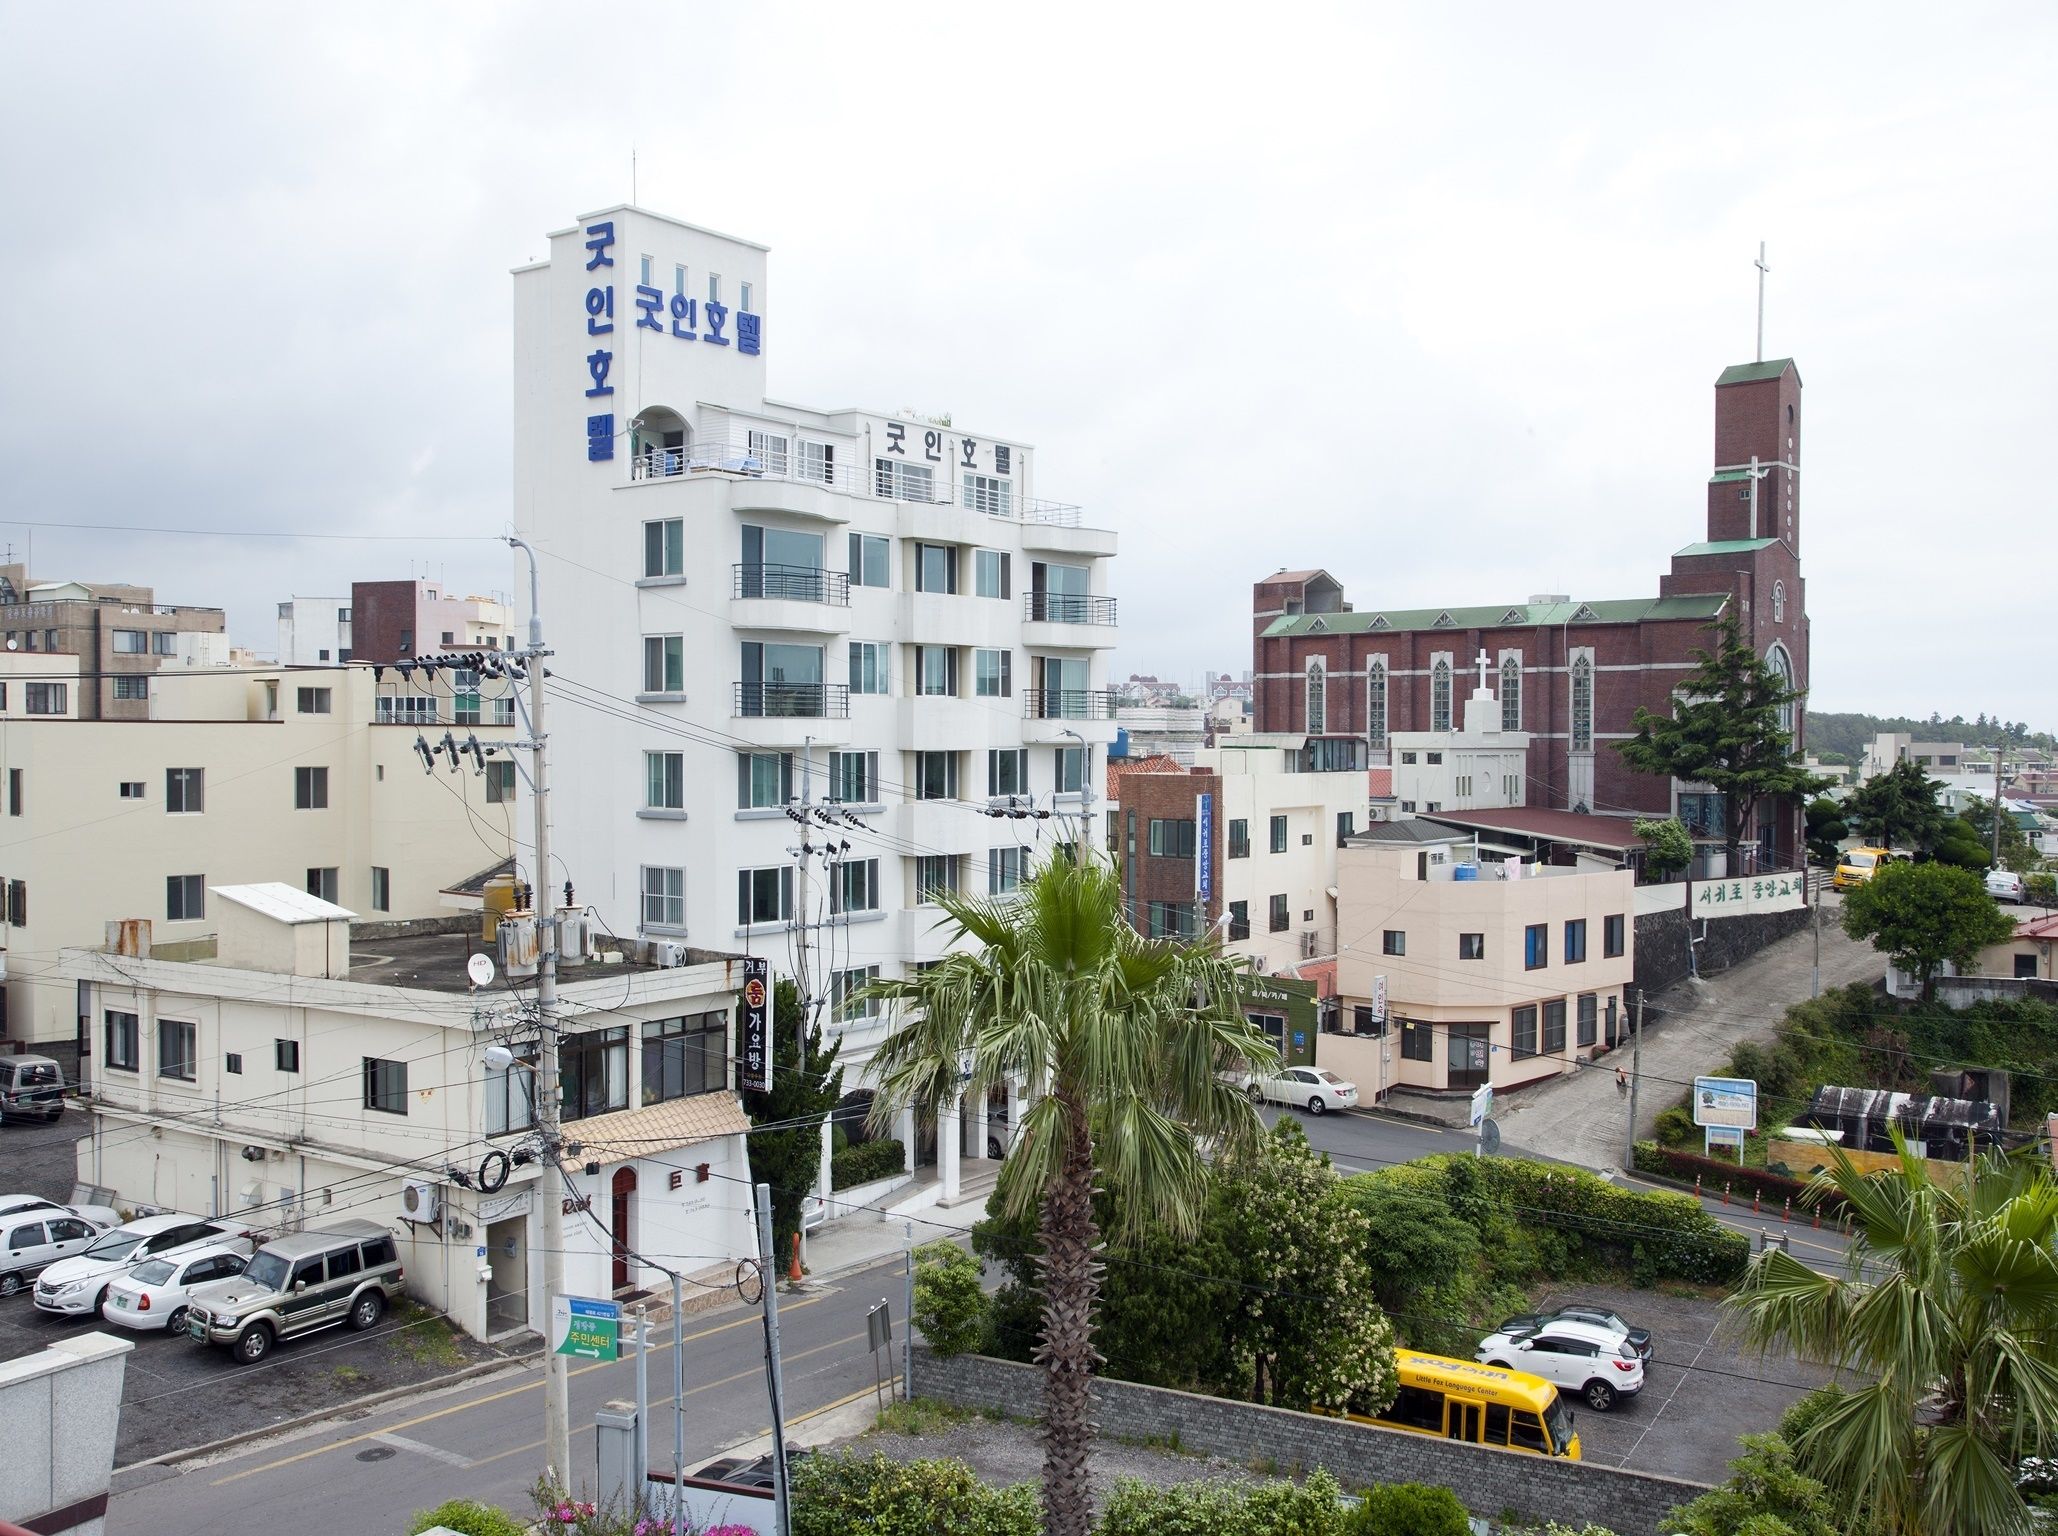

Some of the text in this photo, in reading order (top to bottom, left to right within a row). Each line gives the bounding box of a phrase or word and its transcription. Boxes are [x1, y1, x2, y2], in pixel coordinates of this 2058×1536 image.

[635, 284, 761, 356] 굿인호텔
[585, 221, 615, 462] 굿인호텔
[886, 422, 1011, 475] 굿인호텔
[1699, 877, 1803, 905] 서귀포 중앙교회
[745, 960, 767, 976] 거부
[570, 1331, 610, 1349] 주민센터
[1415, 1374, 1498, 1396] Little Fox Language Center
